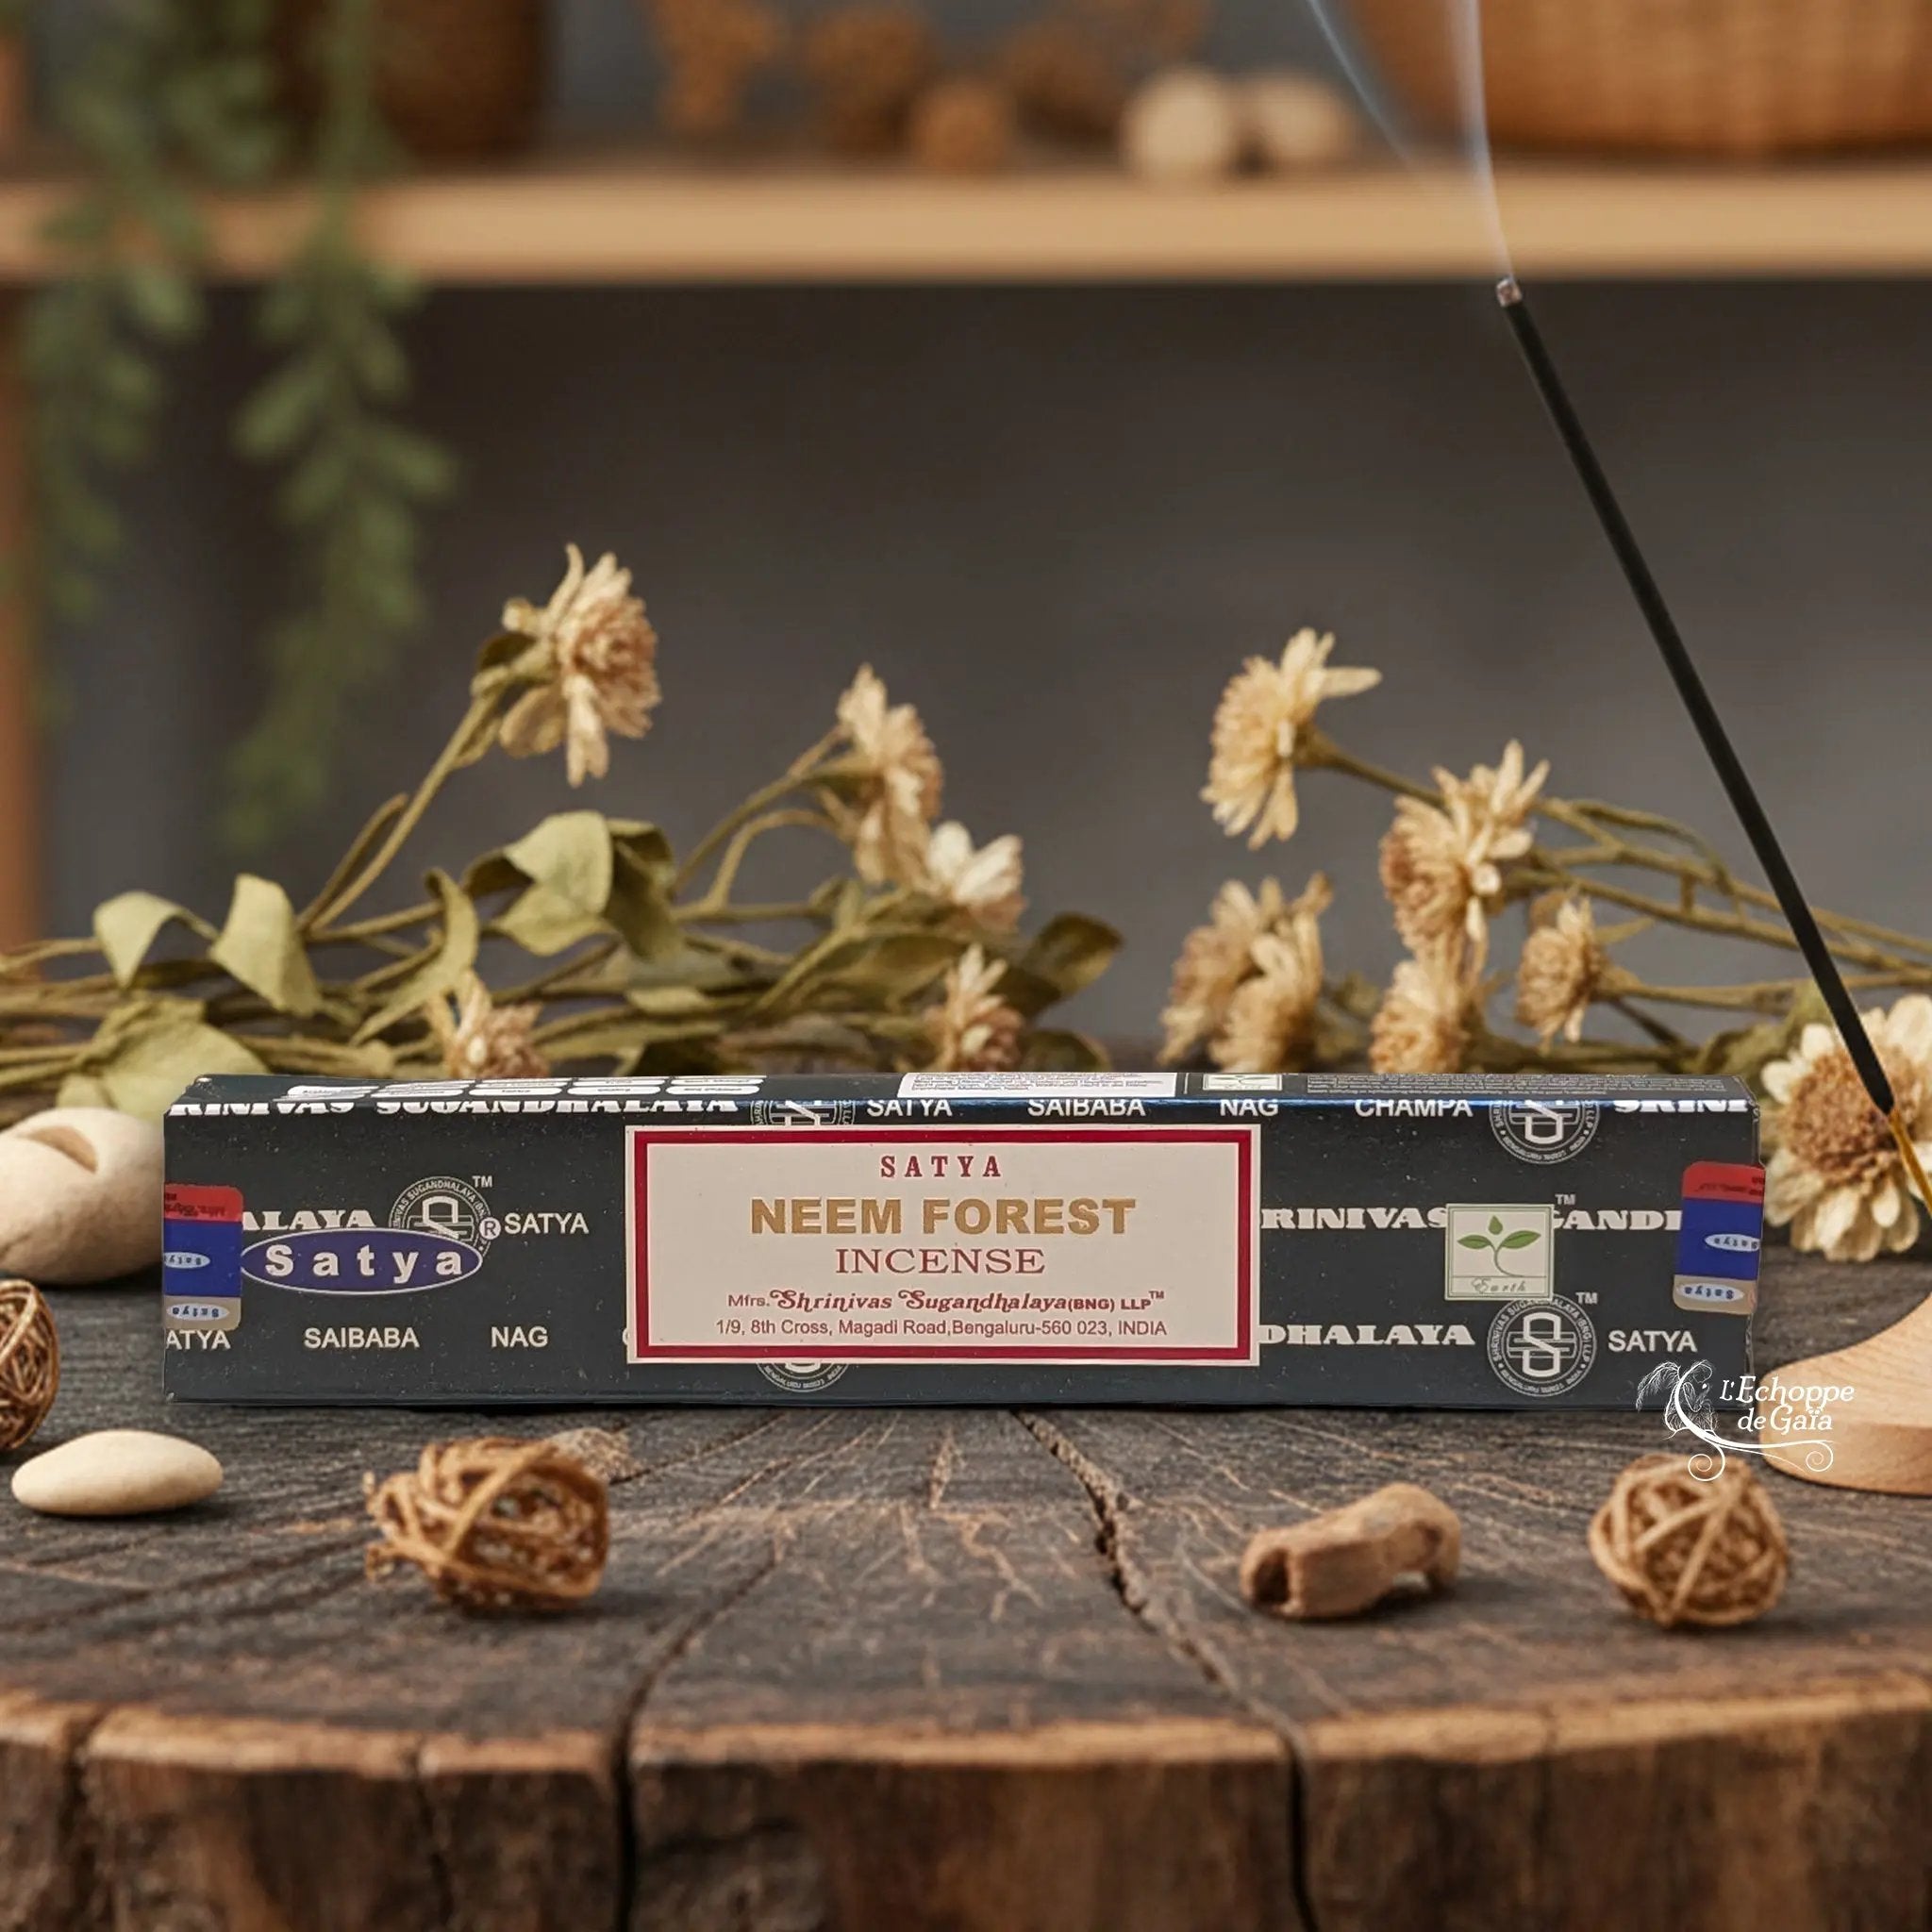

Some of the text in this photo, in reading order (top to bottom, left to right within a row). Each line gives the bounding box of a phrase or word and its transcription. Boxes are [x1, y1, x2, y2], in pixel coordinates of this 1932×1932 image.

[1219, 1099, 1279, 1117] NAG
[1354, 1099, 1474, 1117] CHAMPA
[879, 1155, 1002, 1178] SATYA
[504, 1213, 590, 1234] SATYA
[751, 1197, 1137, 1236] NEEM FOREST
[265, 1244, 463, 1284] Satya
[836, 1248, 1045, 1274] INCENSE
[304, 1326, 549, 1349] SAIBABA NAG
[717, 1319, 745, 1336] 1/9,
[751, 1319, 776, 1334] 8th
[781, 1319, 833, 1336] Cross,
[839, 1319, 898, 1338] Magadi
[1076, 1320, 1113, 1337] 023,
[1118, 1320, 1168, 1336] INDIA
[1608, 1330, 1698, 1353] SATYA
